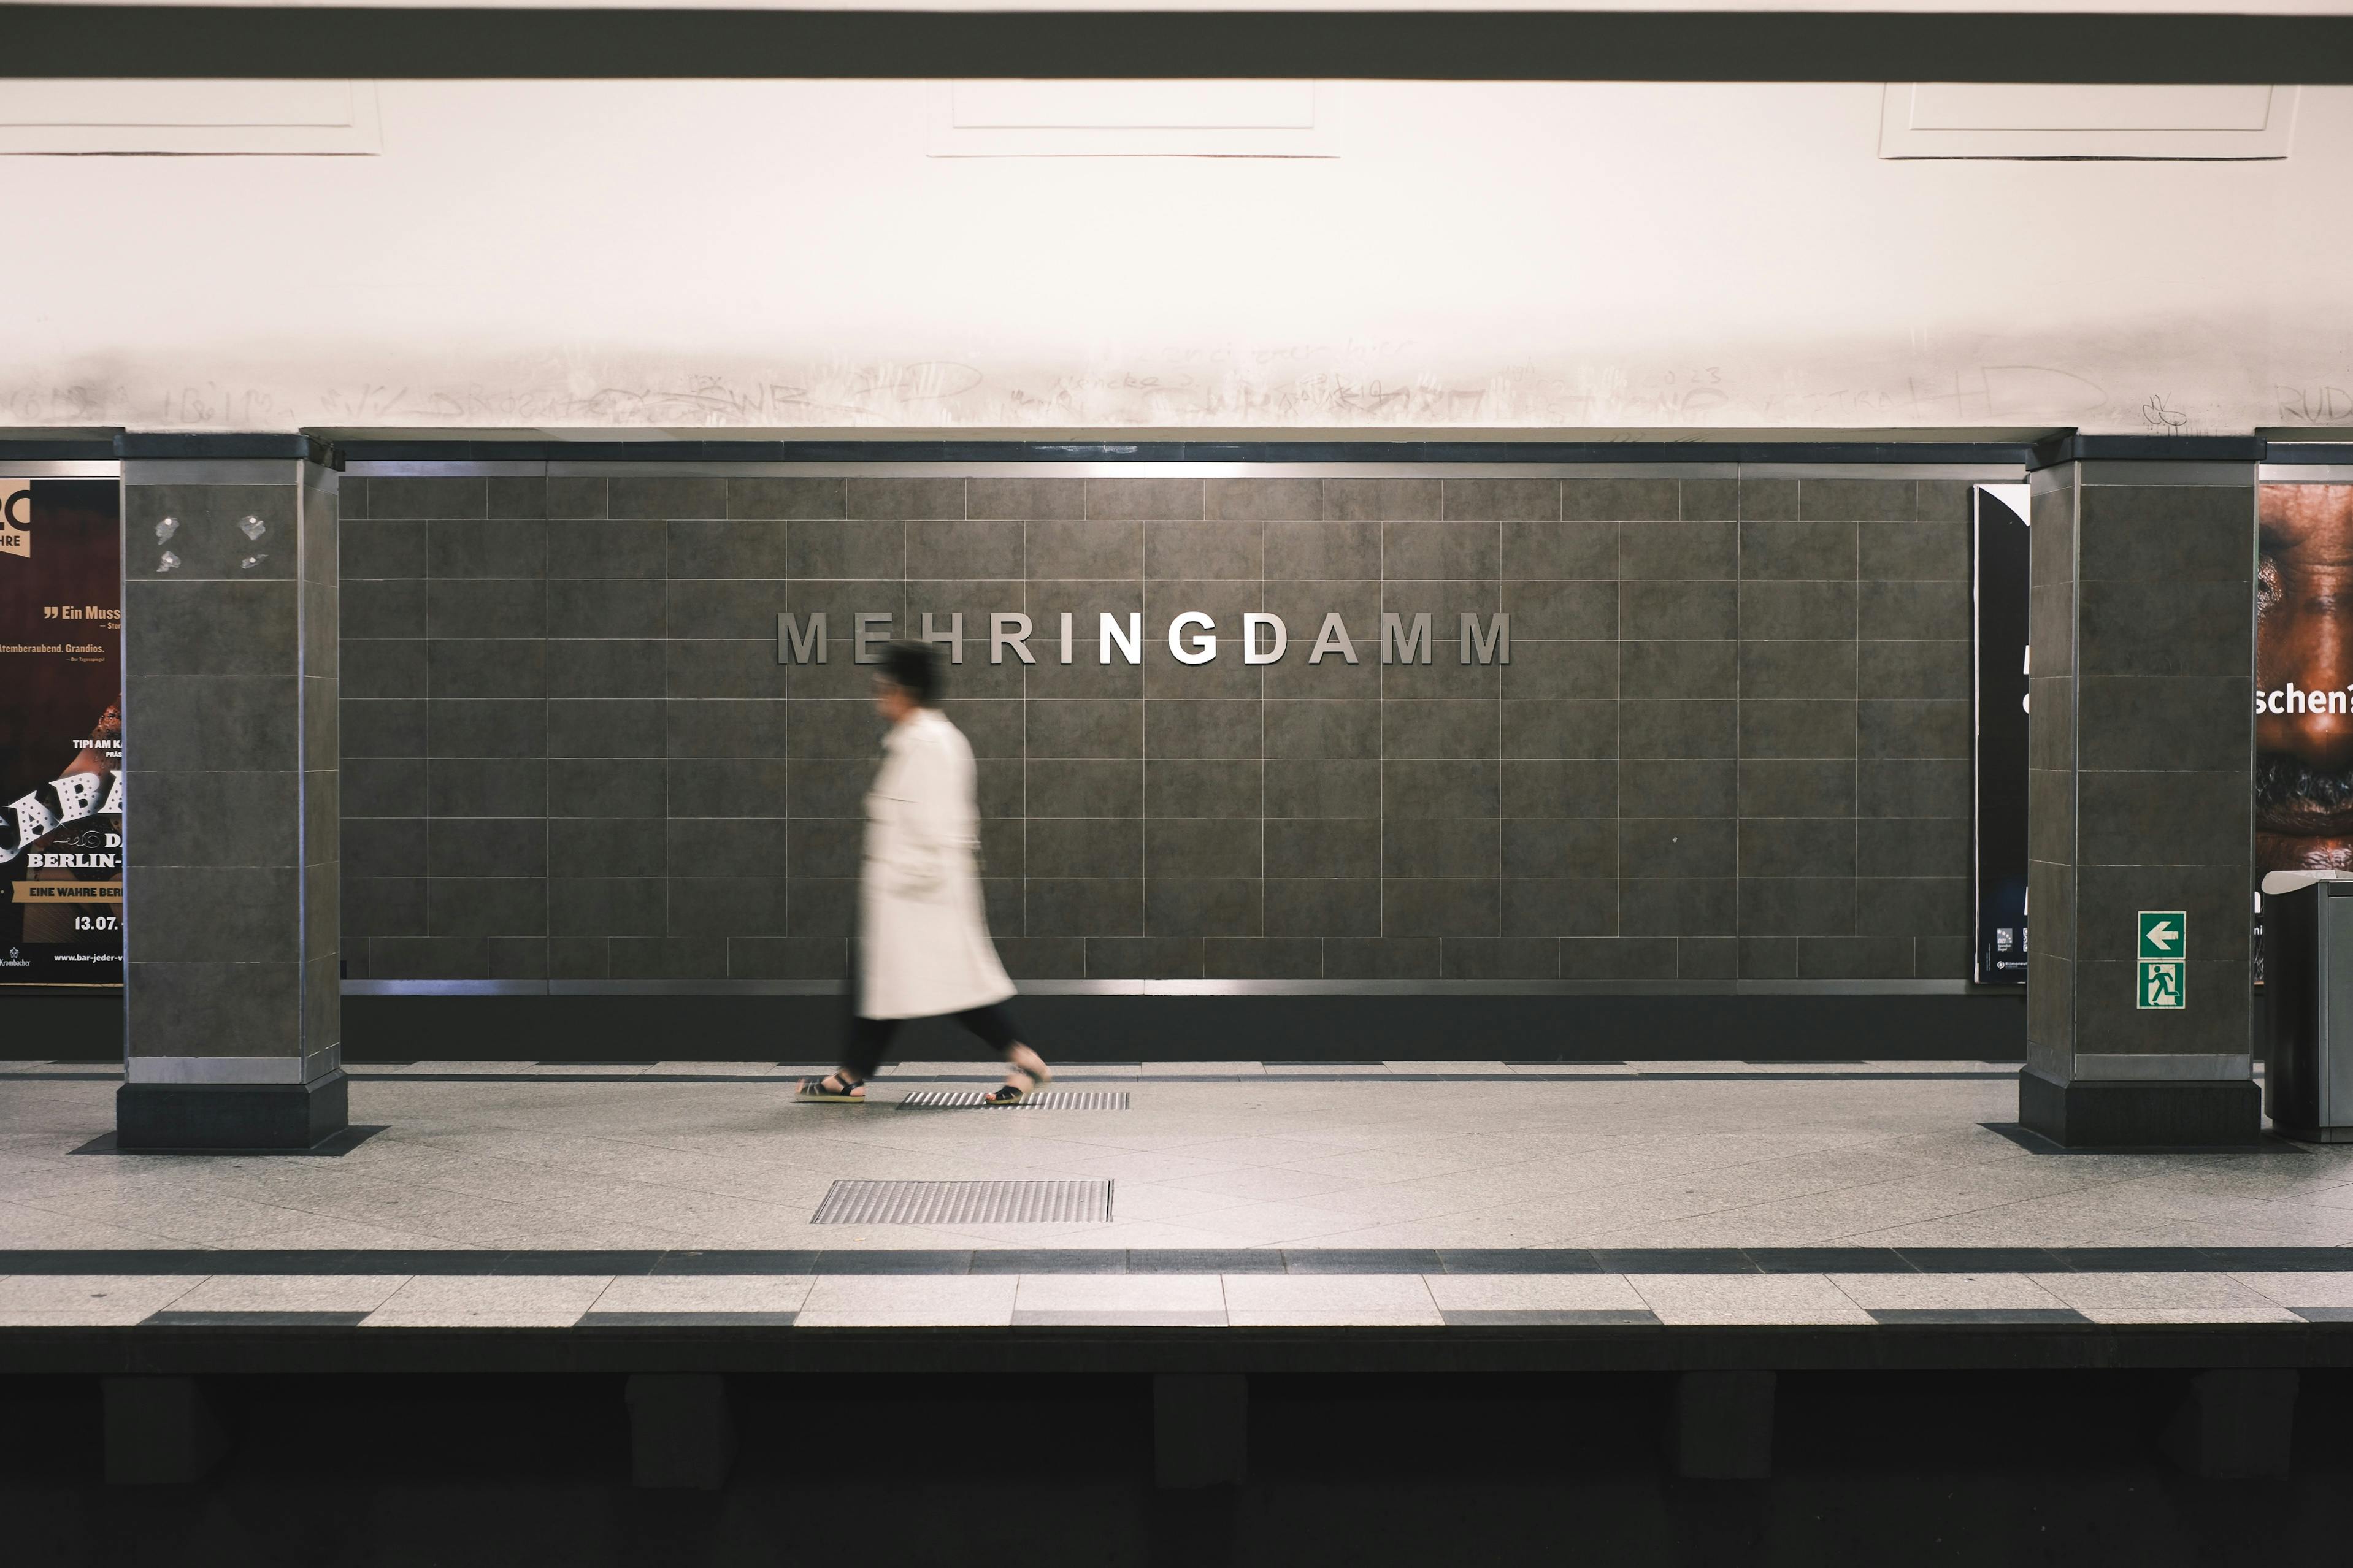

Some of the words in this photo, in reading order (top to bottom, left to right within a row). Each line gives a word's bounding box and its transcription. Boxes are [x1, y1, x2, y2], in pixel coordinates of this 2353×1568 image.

[85, 606, 121, 619] Muss
[777, 612, 1511, 664] MEHRINGDAMM
[65, 644, 105, 653] Grandios.
[73, 740, 93, 748] TIPI
[94, 740, 111, 748] AM
[27, 854, 121, 868] BERLIN-
[29, 887, 55, 897] EINE
[58, 887, 97, 897] WAHRE
[75, 917, 118, 930] 13.07.
[54, 954, 123, 963] www.bar-jeder-v
